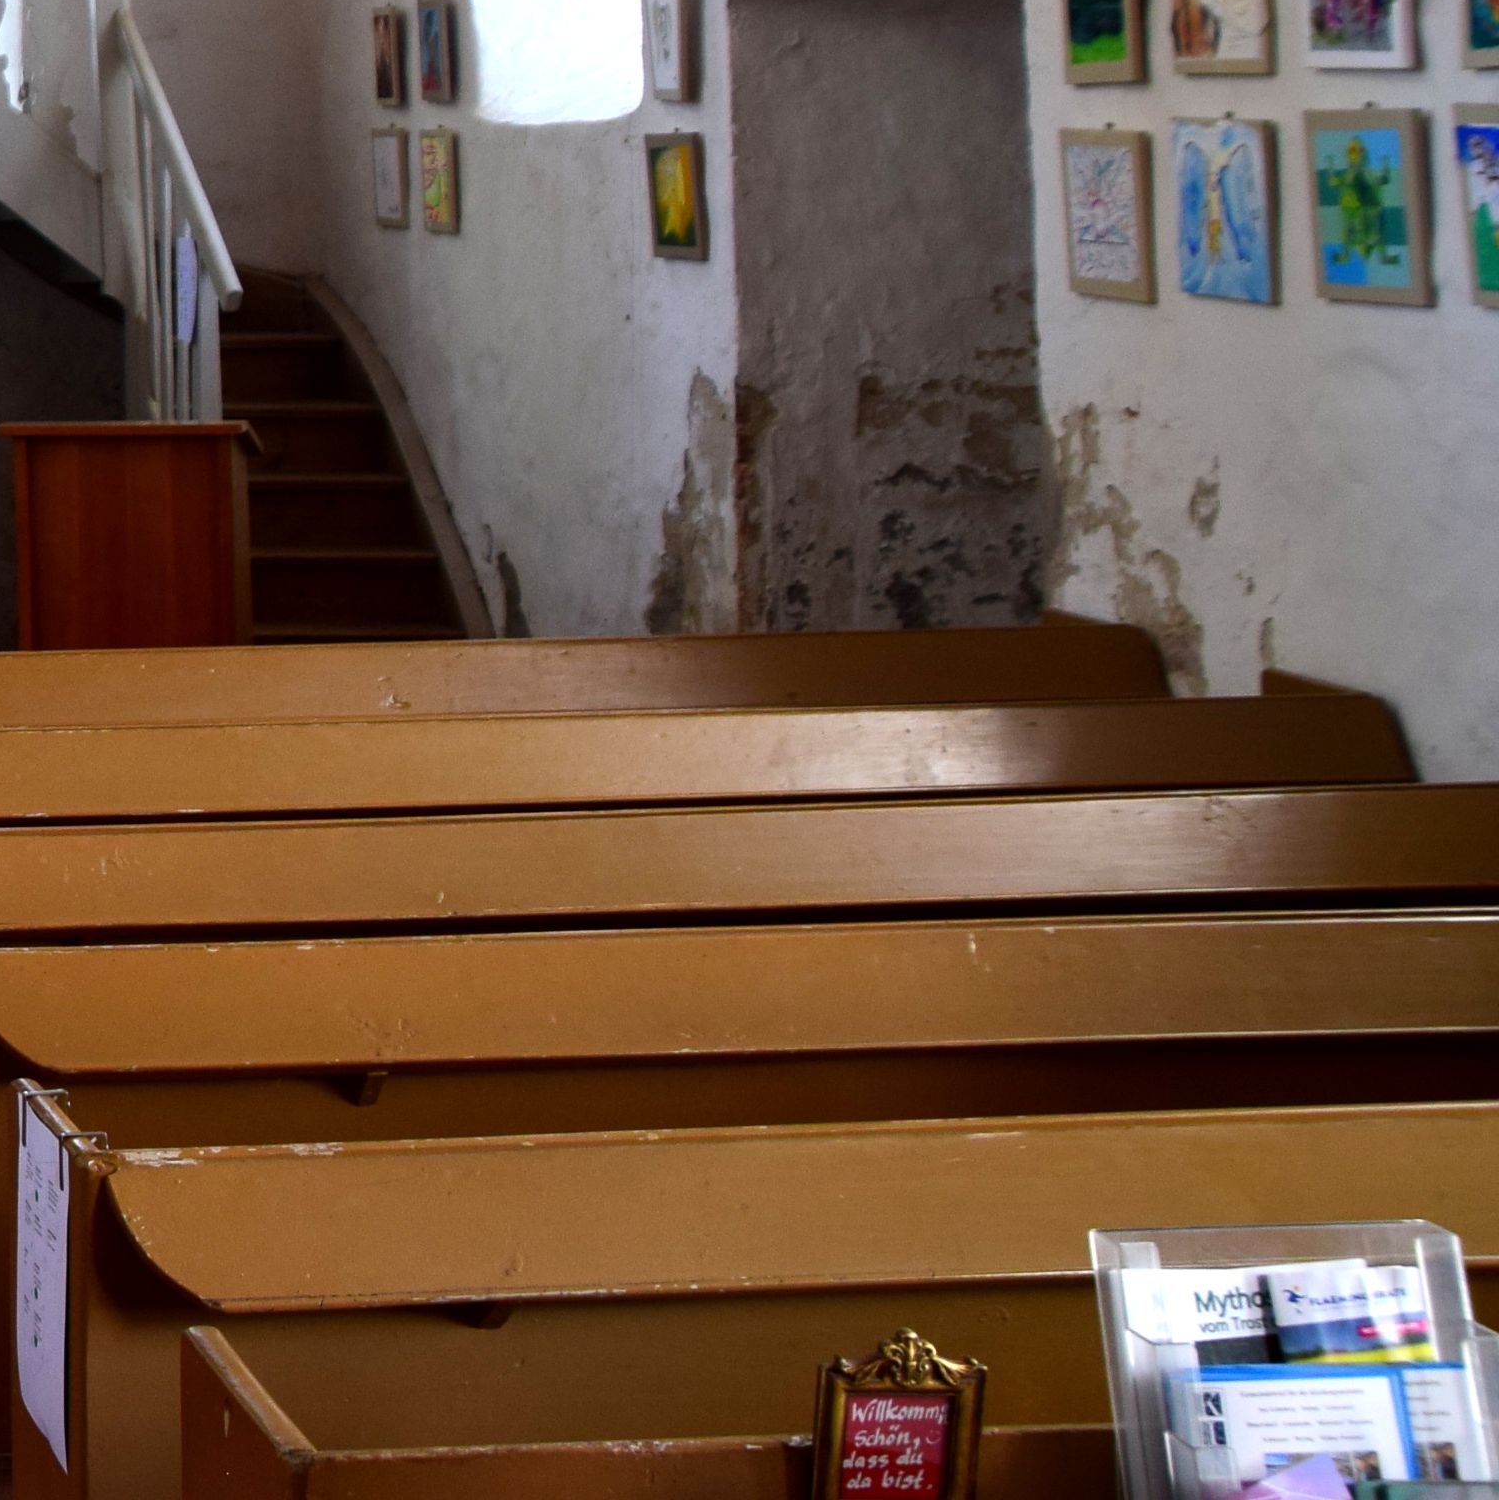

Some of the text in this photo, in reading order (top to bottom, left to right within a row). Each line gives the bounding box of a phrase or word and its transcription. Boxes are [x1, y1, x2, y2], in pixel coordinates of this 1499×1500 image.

[1199, 1320, 1229, 1333] vom
[843, 1447, 923, 1468] dass du
[847, 1472, 872, 1489] da
